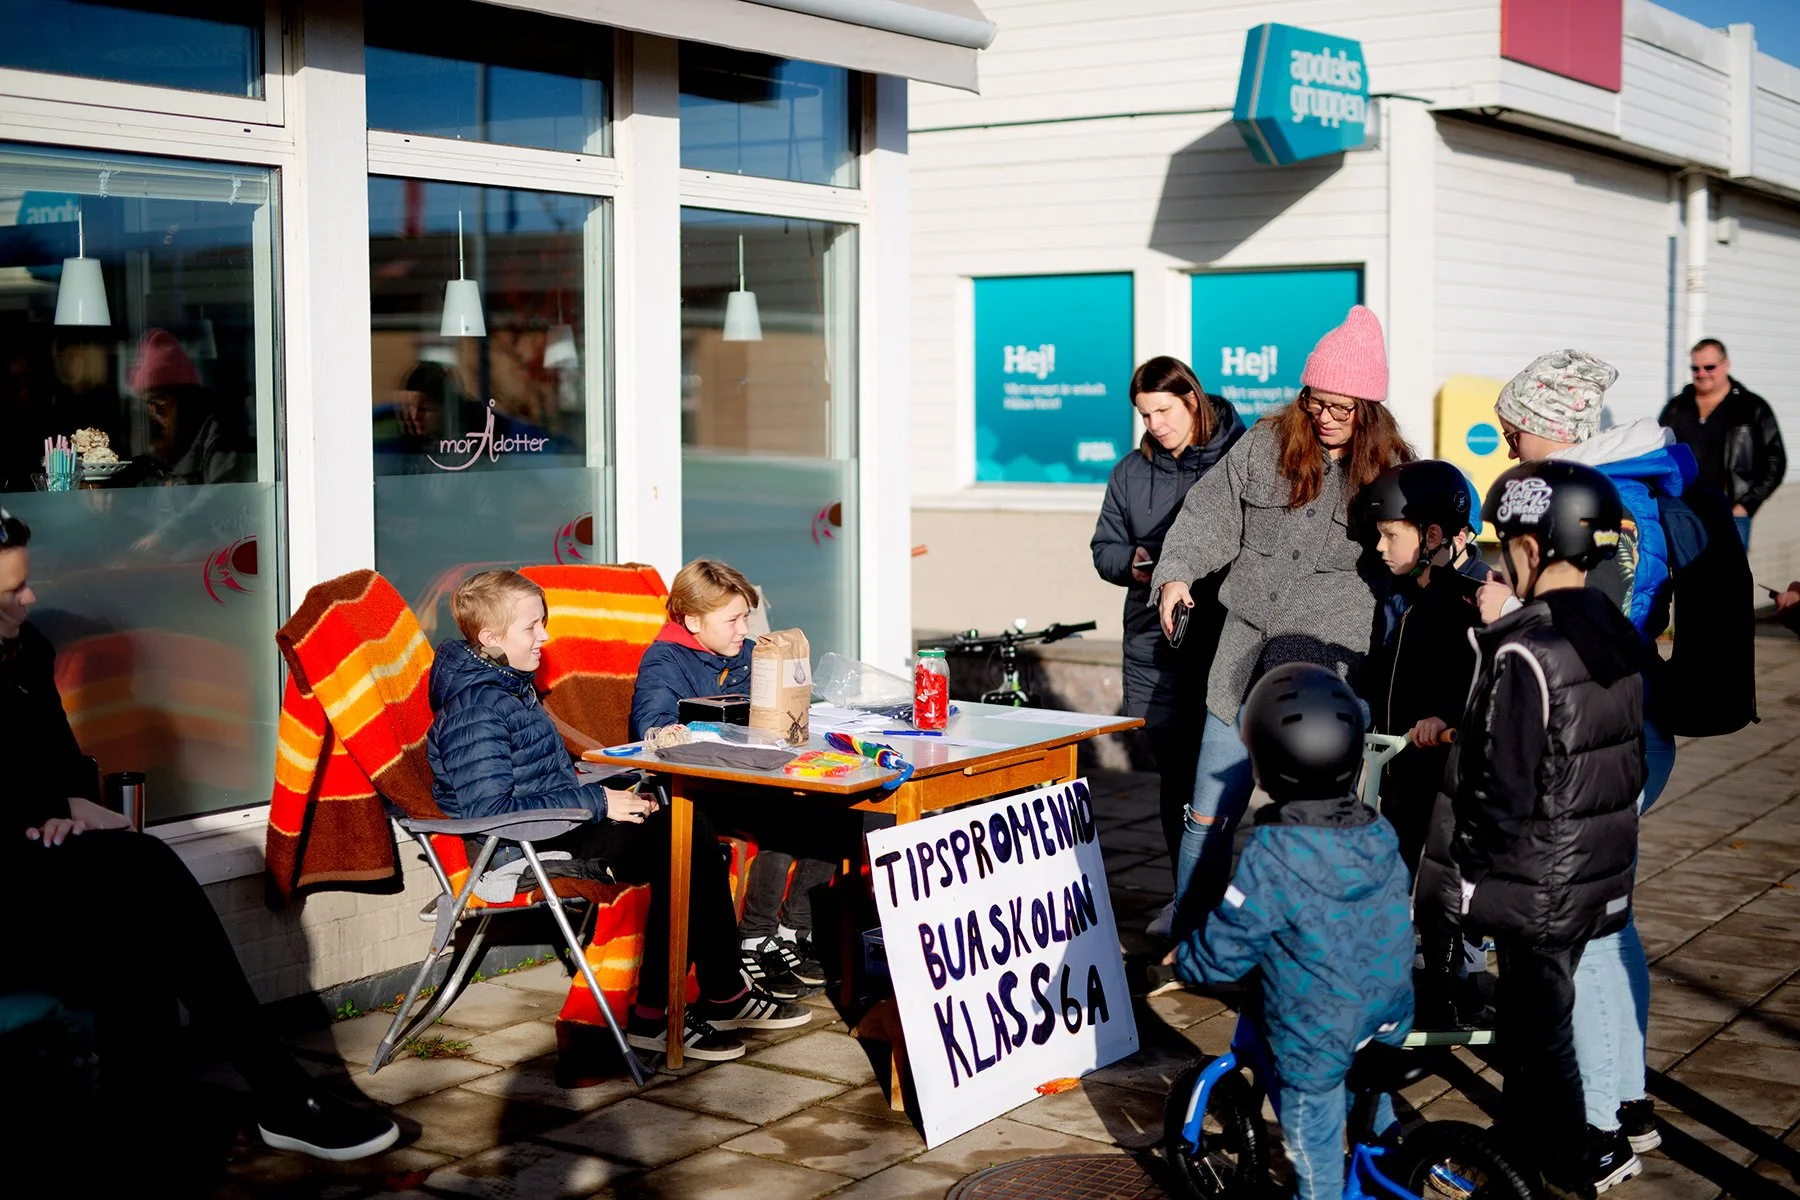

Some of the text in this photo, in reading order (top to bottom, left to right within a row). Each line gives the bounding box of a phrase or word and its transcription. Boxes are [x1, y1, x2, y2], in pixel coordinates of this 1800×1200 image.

[1290, 47, 1362, 91] apoteks
[1290, 84, 1366, 128] gruppen
[1003, 344, 1055, 379] Hej!
[1221, 345, 1278, 382] Hej!
[875, 782, 1096, 907] TIPSPROMENAD
[918, 873, 1098, 990] BUASKOLAN
[934, 962, 1056, 1088] KLASS
